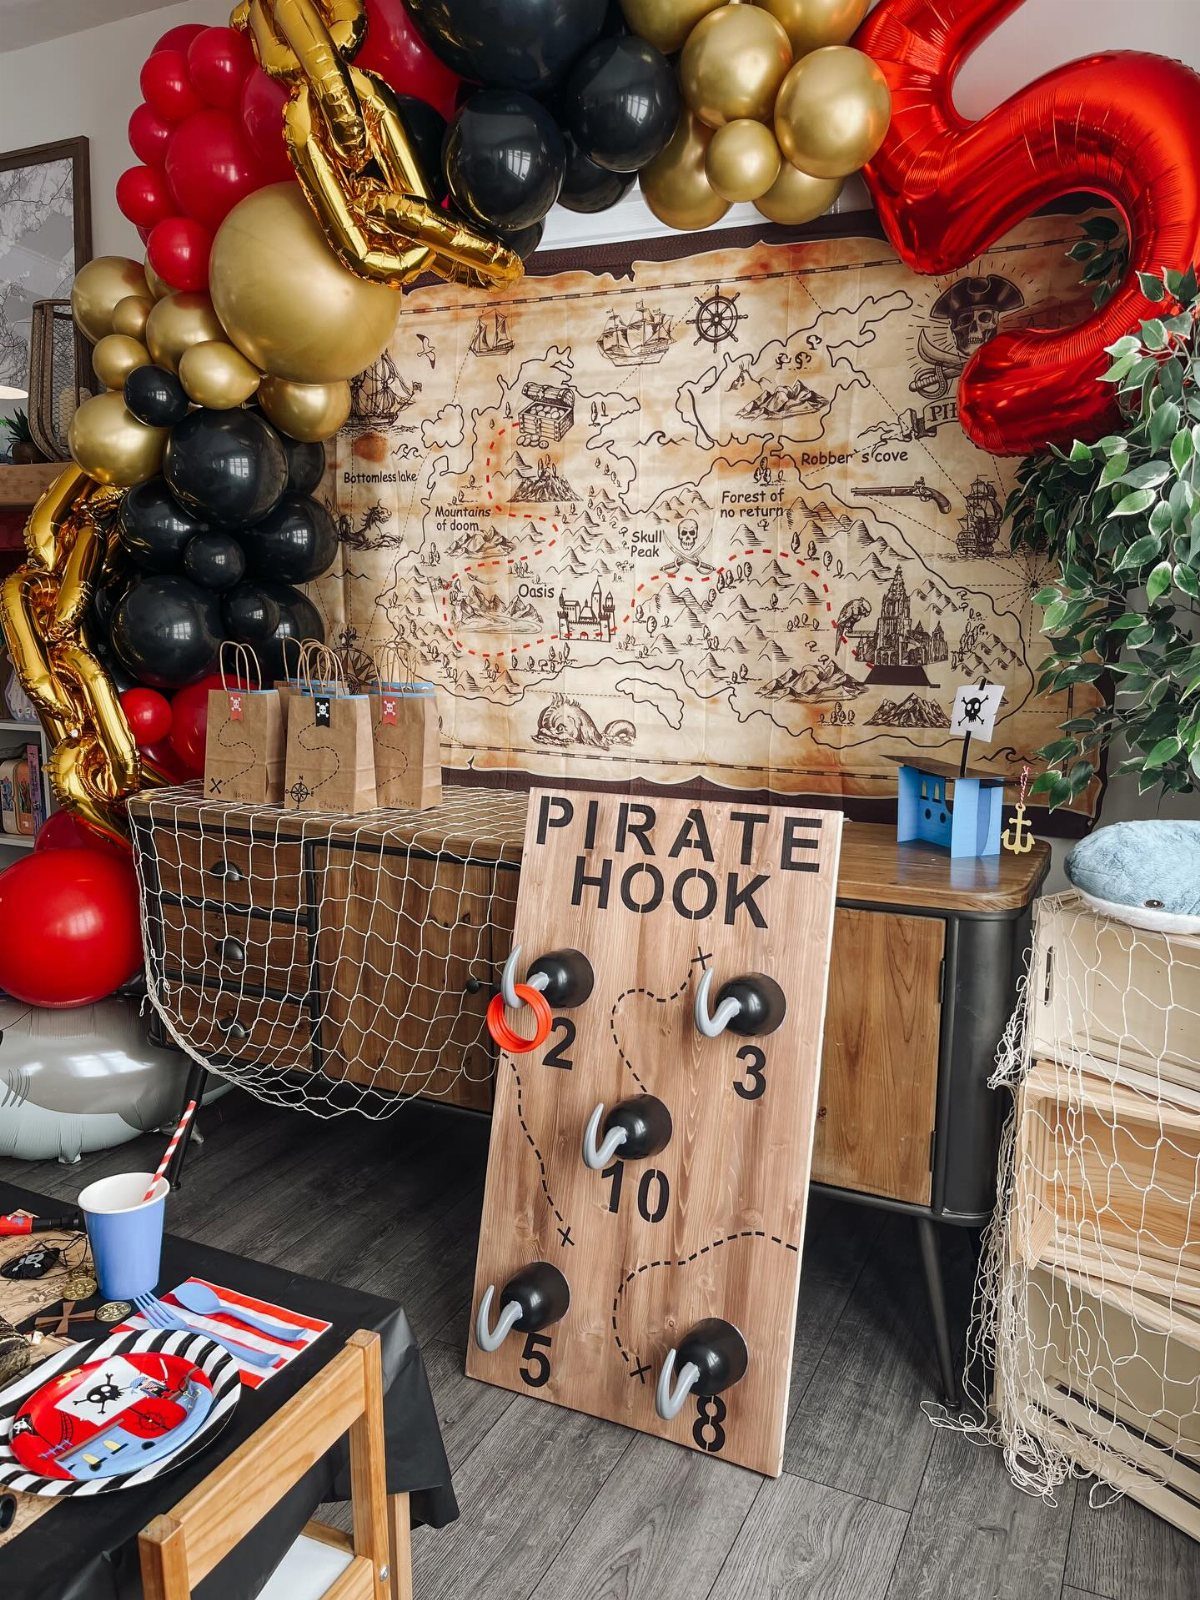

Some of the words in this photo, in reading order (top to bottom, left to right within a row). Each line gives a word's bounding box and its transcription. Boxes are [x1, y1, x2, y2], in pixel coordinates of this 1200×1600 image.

[875, 451, 909, 462] cove
[344, 470, 397, 483] Bottomless
[399, 470, 418, 482] lake
[721, 491, 766, 503] Forest
[770, 488, 785, 502] of
[435, 506, 491, 518] Mountains
[720, 508, 735, 518] no
[740, 506, 784, 518] return
[436, 519, 449, 531] of
[450, 519, 479, 531] doom
[631, 530, 662, 543] Skull
[630, 545, 660, 557] Peak
[518, 584, 555, 598] Oasis
[536, 796, 823, 873] PIRATE
[571, 856, 771, 929] HOOK
[542, 1017, 577, 1070] 2
[732, 1045, 767, 1100] 3
[600, 1160, 670, 1223] 10
[519, 1333, 552, 1387] 5
[692, 1395, 727, 1452] 8
